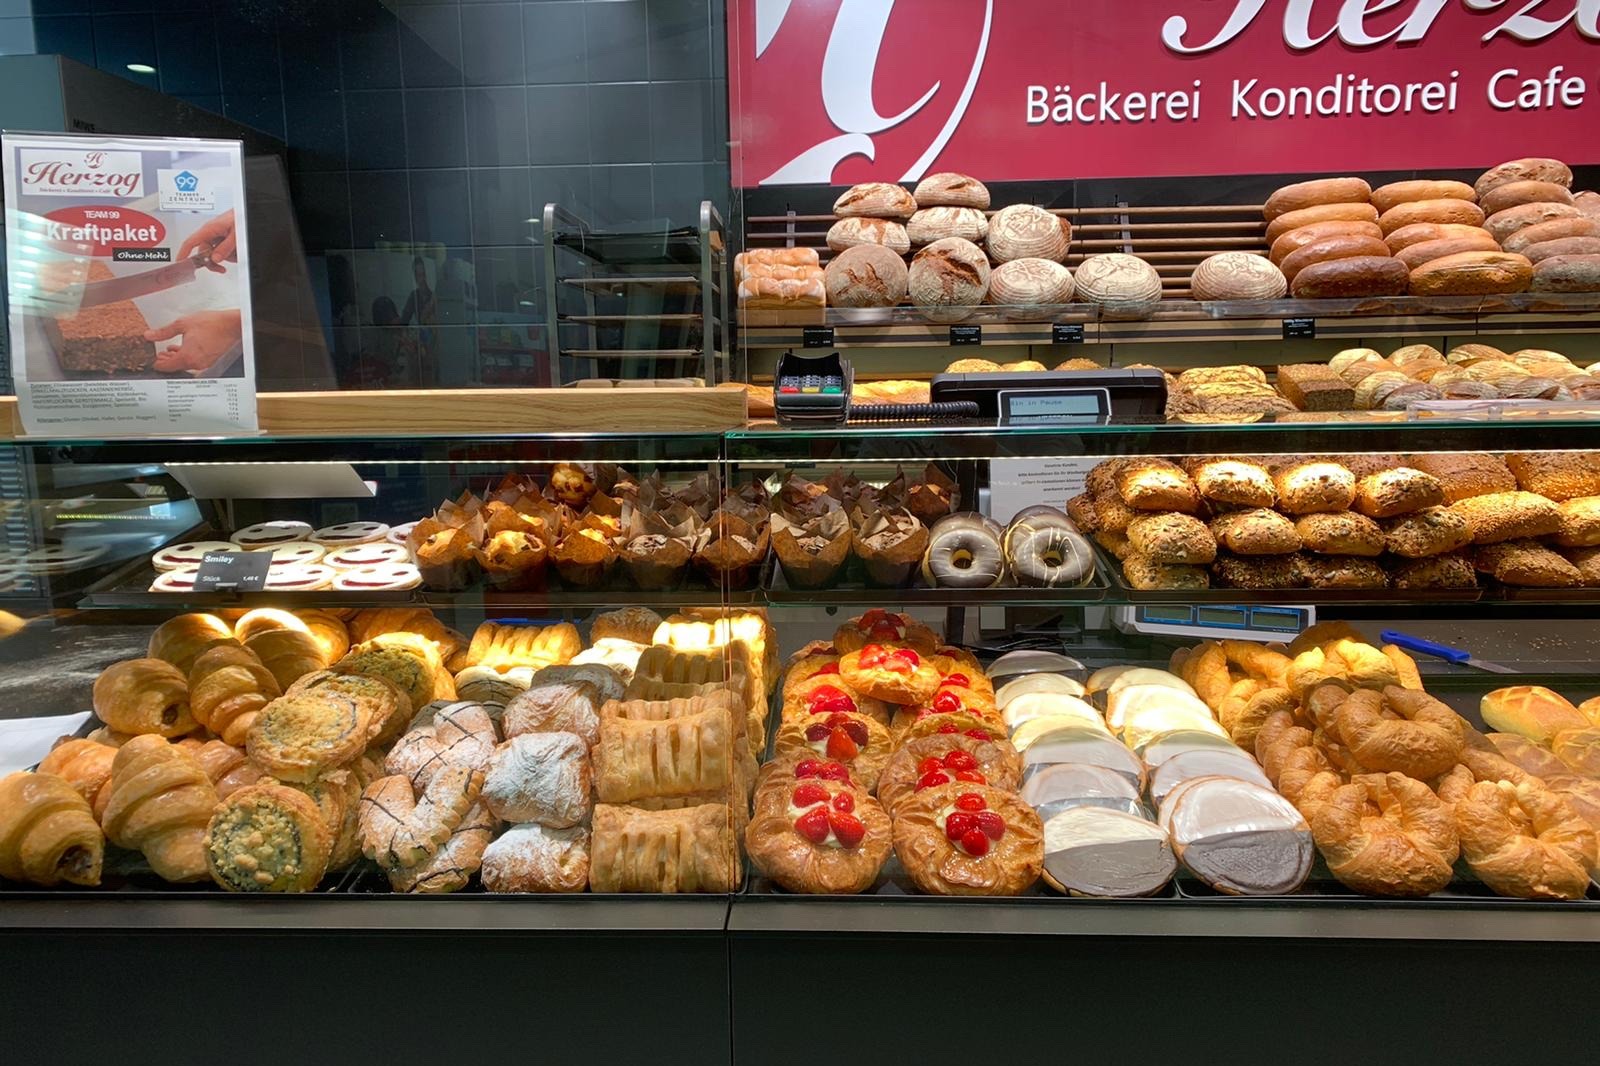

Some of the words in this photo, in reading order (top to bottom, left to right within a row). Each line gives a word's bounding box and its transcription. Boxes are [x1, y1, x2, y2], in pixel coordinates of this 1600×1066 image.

[1026, 79, 1202, 124] Bäckerei
[1231, 71, 1459, 118] Konditorei
[1486, 66, 1587, 109] Cafe
[23, 160, 141, 197] Herzog
[176, 176, 196, 189] 99
[84, 210, 108, 219] TEAM
[108, 211, 120, 220] 99
[46, 223, 158, 246] Kraftpaket
[117, 252, 144, 260] Ohne
[144, 251, 169, 260] Mehl
[204, 554, 234, 564] Smiley
